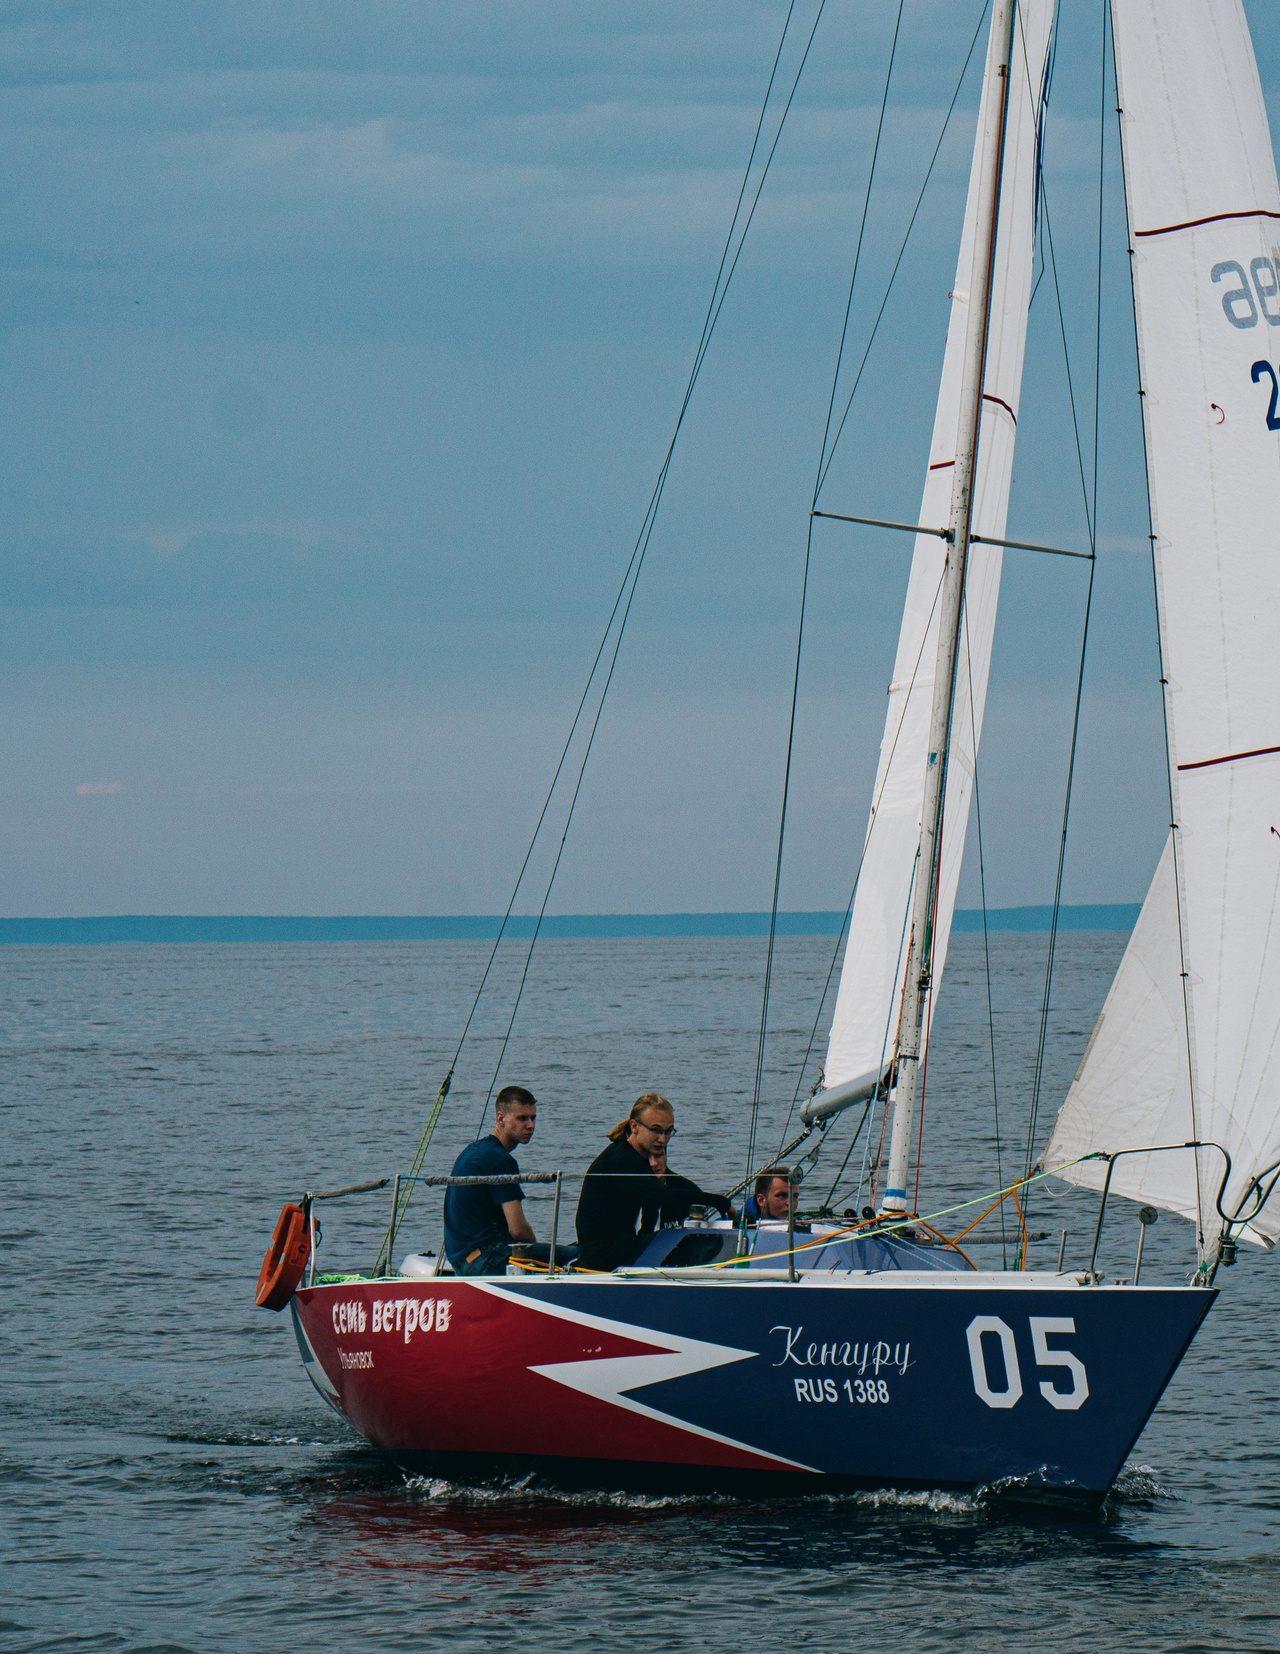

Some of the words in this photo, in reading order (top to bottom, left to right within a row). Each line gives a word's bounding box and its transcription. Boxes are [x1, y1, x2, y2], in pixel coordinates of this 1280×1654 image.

[769, 1325, 917, 1376] Кенгуру
[966, 1315, 1089, 1410] 05
[794, 1378, 838, 1403] RUS
[843, 1379, 890, 1404] 1388
